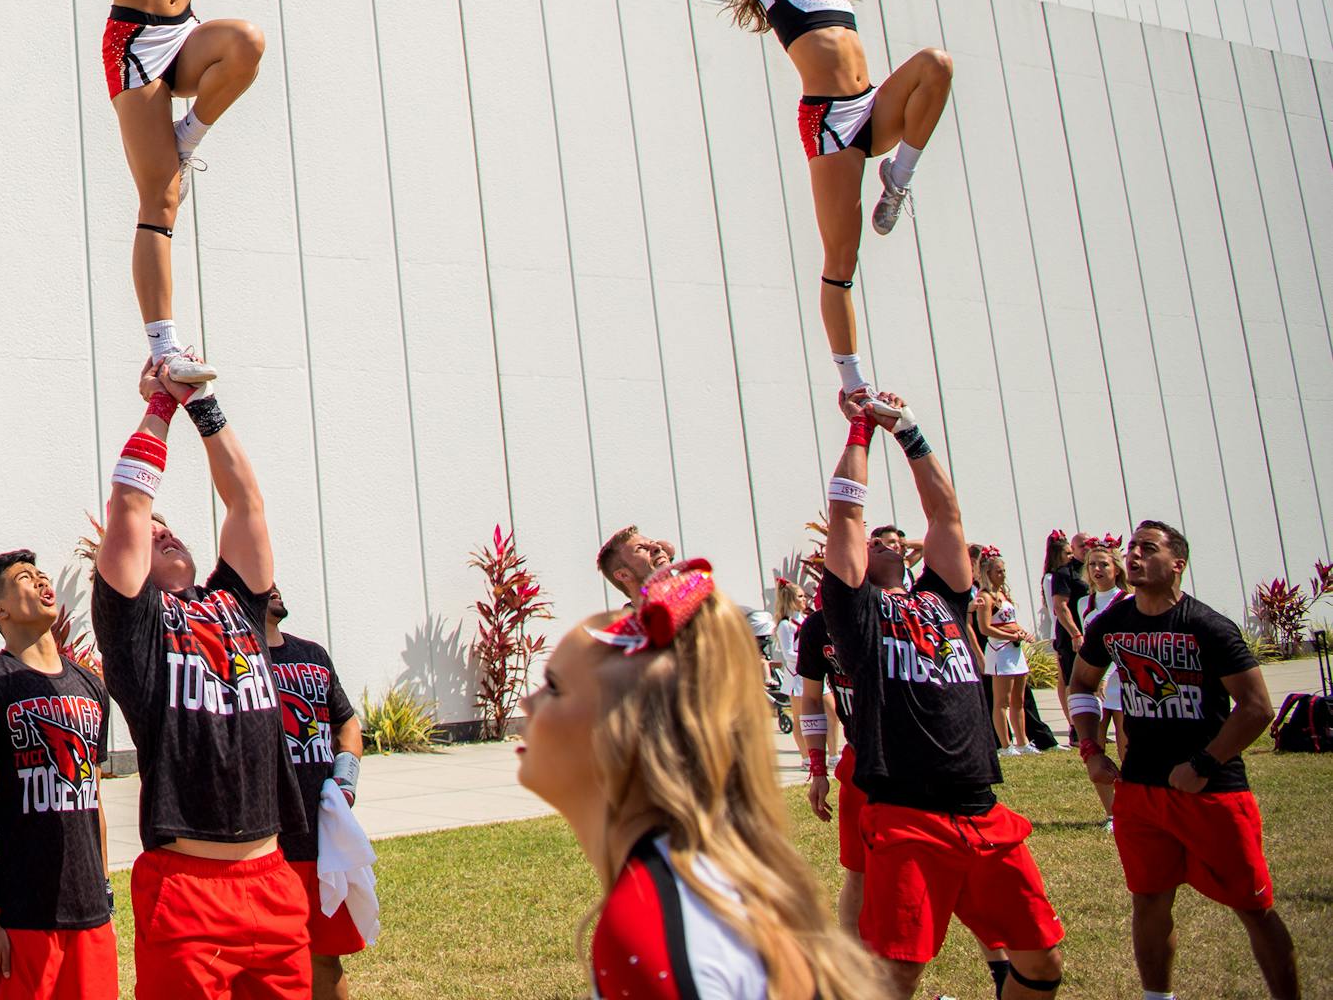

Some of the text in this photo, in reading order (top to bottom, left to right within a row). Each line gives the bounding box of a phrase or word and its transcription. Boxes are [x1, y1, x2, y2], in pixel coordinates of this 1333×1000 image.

[883, 637, 980, 686] TOGEHER
[1102, 631, 1203, 671] STRONGER
[166, 651, 278, 715] TOGEHE
[1120, 682, 1205, 720] OGEHER
[13, 750, 46, 769] TVCC
[17, 765, 99, 815] TOGEHE
